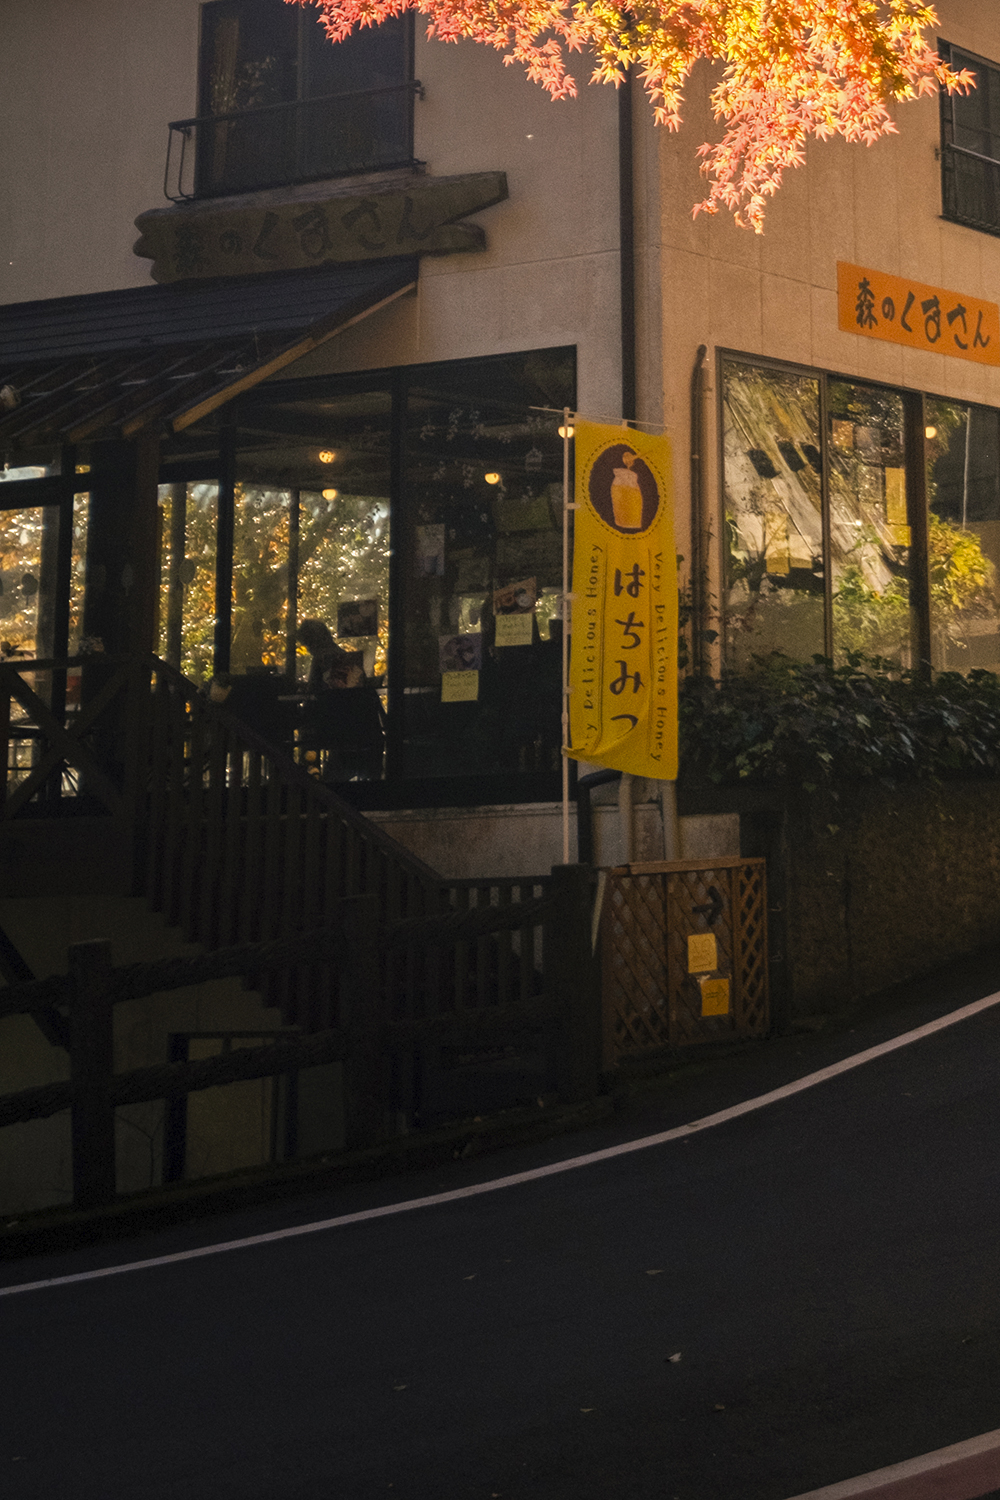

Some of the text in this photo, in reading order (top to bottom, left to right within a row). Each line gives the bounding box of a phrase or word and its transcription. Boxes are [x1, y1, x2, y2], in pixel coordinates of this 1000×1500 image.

[855, 277, 990, 350] 森のくまさん
[585, 544, 603, 598] Honey
[582, 608, 597, 710] Delicious
[609, 562, 646, 739] はちみつ
[650, 552, 668, 761] Very Delicious Honey
